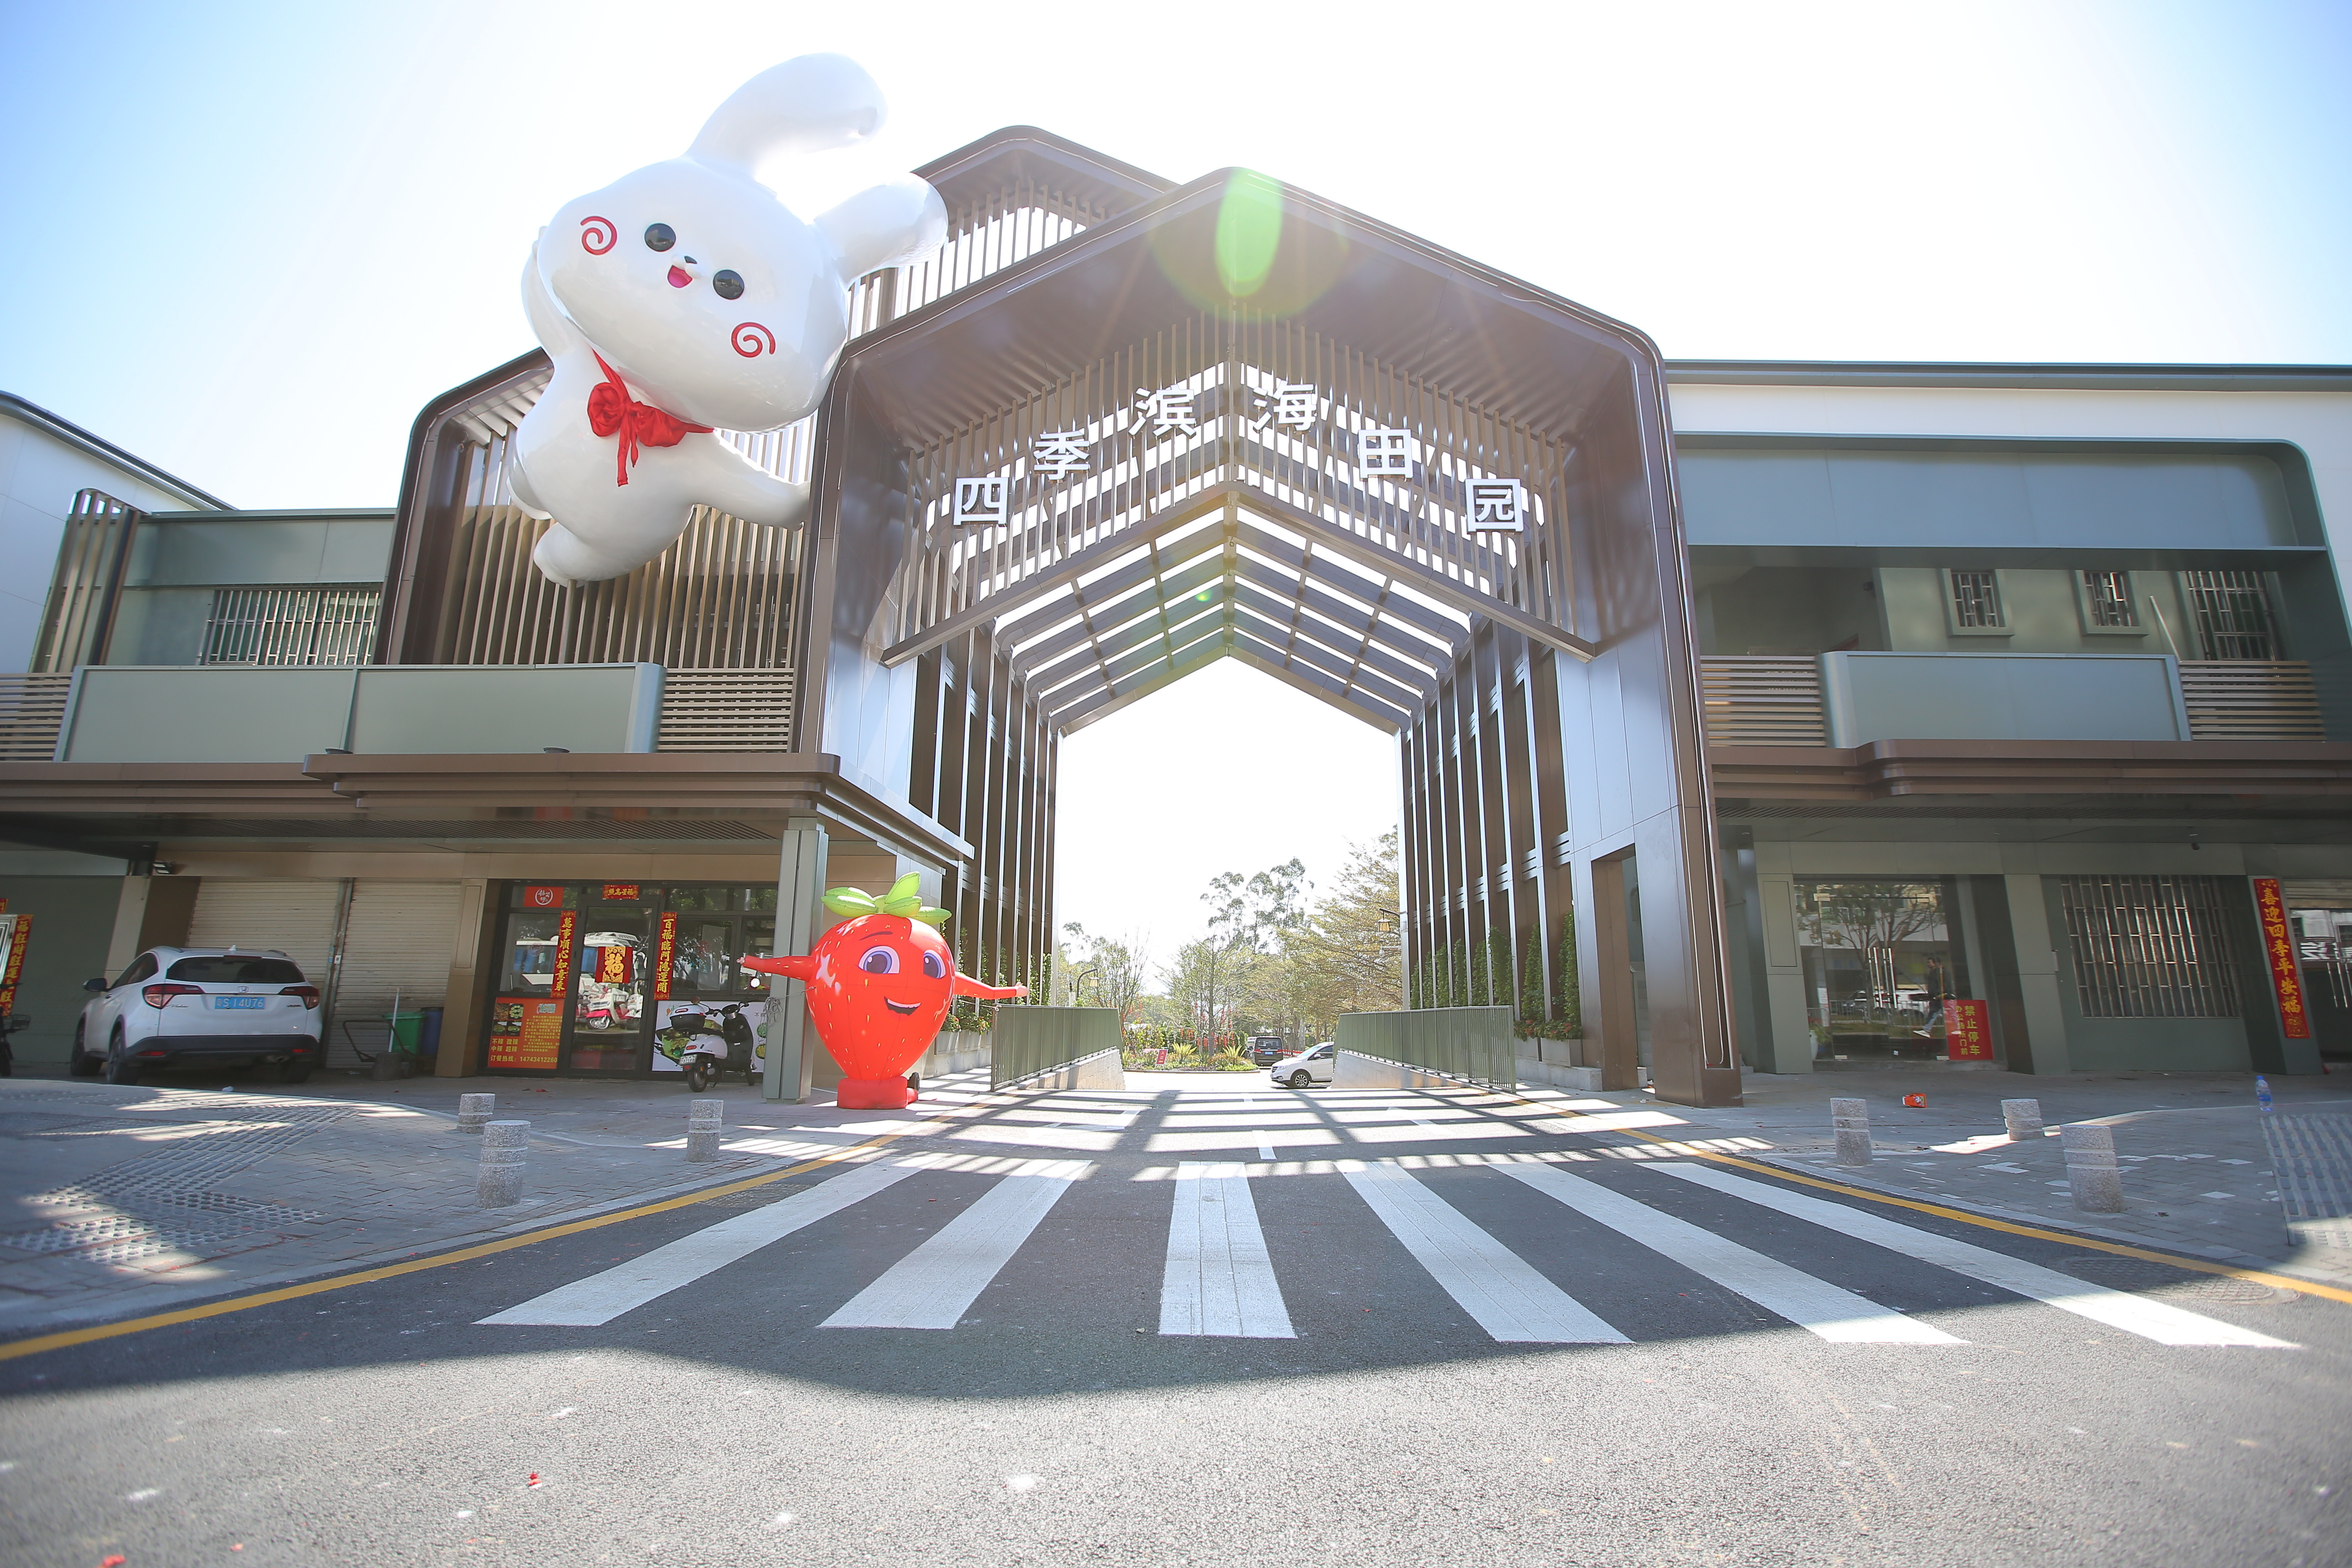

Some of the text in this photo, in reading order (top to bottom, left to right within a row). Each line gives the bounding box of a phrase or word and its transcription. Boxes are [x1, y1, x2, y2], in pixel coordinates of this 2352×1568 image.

[953, 380, 1524, 532] 四季滨海田园
[605, 953, 624, 975] 福
[2261, 887, 2301, 1013] 喜迎四季平安福
[1955, 1005, 1968, 1055] 办公场所门前
[1964, 1005, 1981, 1055] 禁止停车
